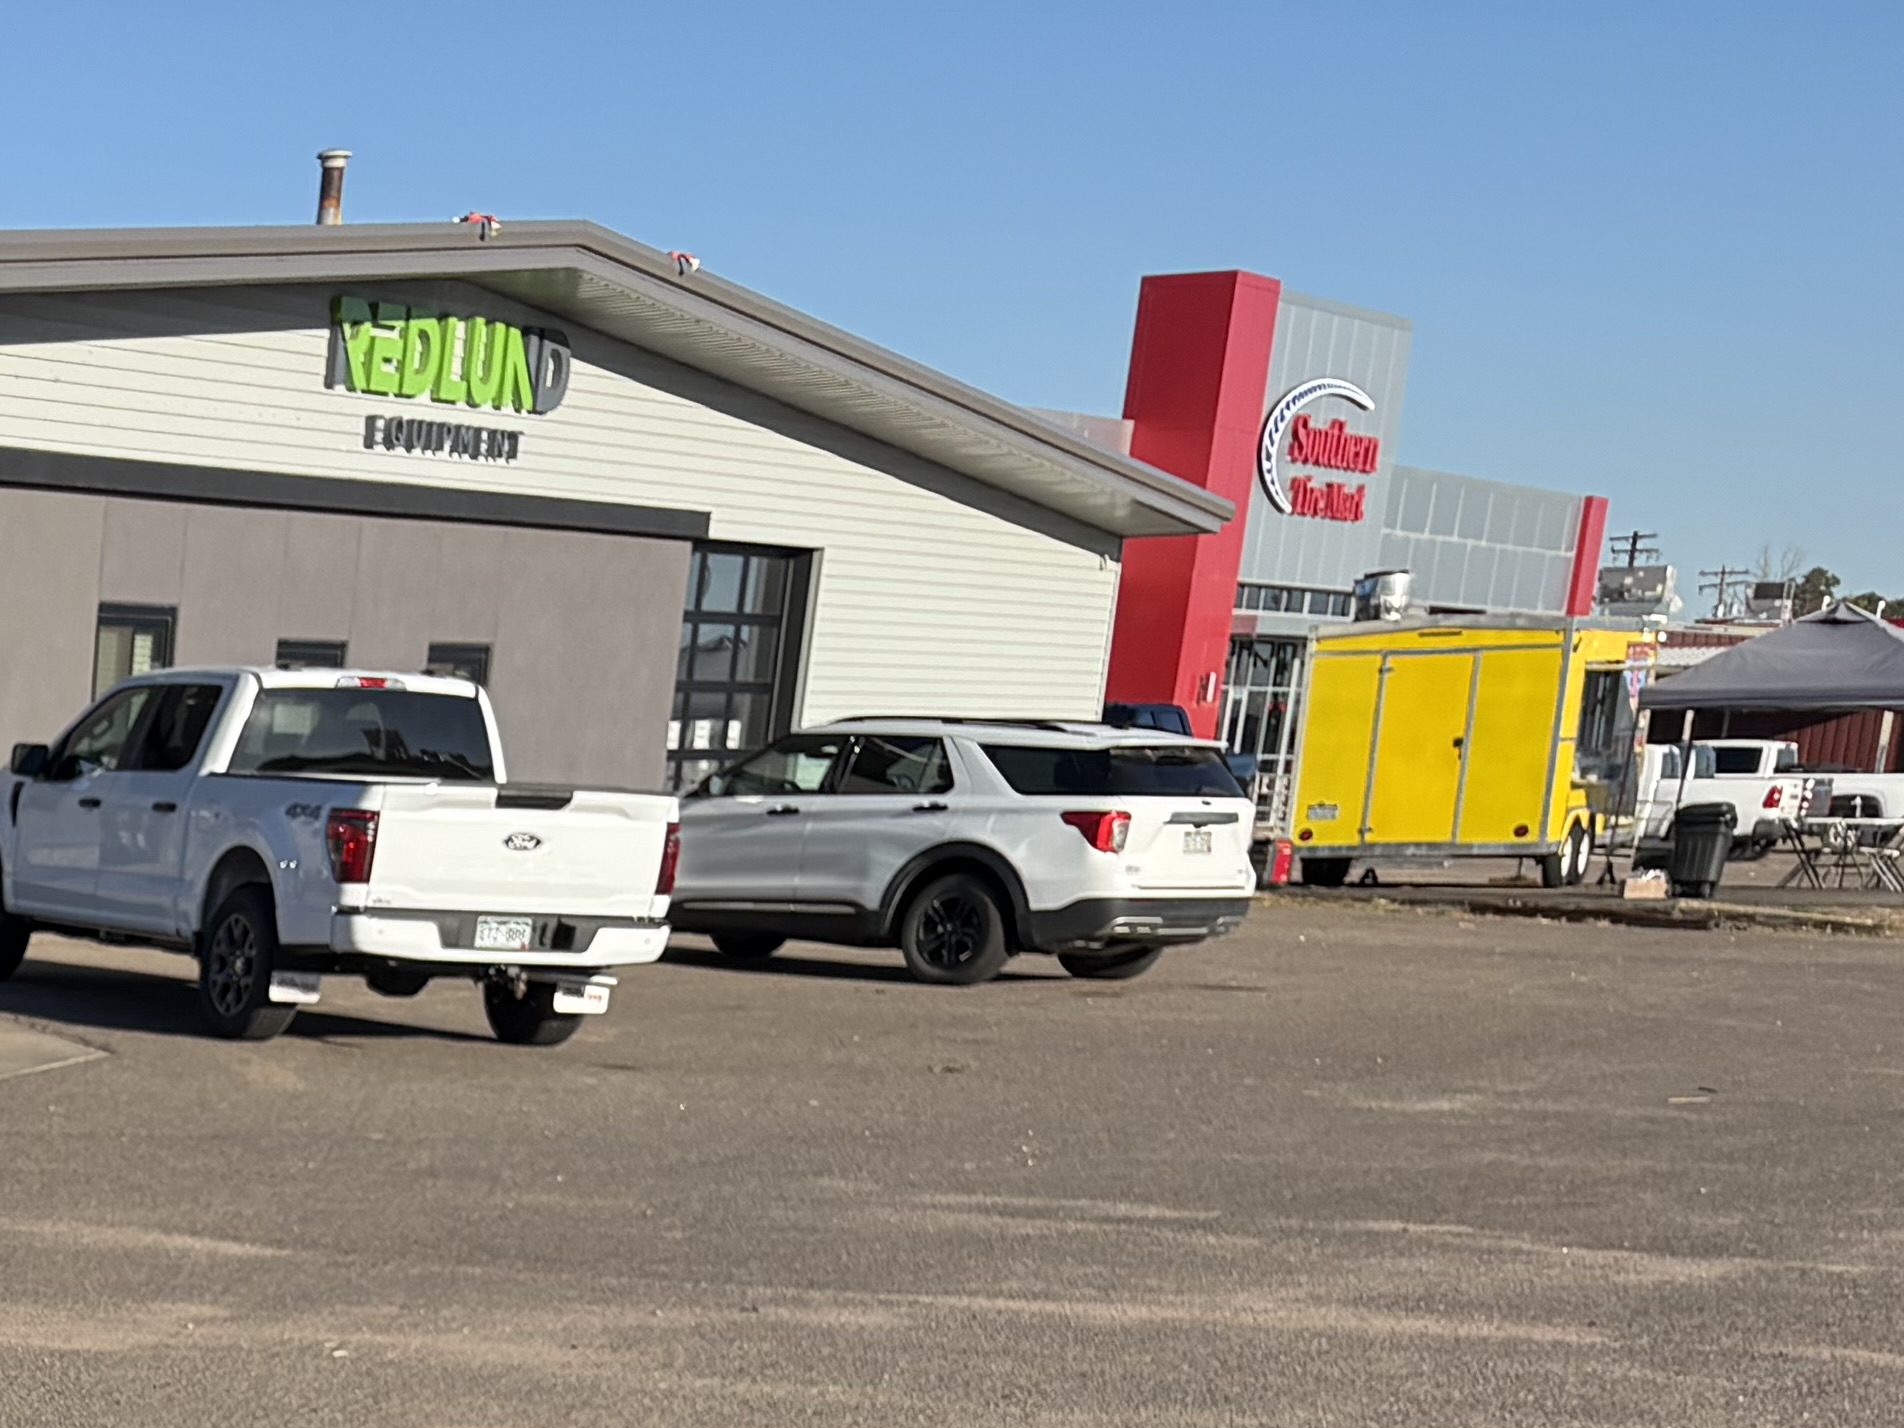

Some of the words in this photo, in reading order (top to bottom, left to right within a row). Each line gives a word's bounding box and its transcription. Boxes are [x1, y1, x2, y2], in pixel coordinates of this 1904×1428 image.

[324, 297, 571, 414] REDLUND
[363, 415, 524, 464] EQUIPMENT
[1288, 414, 1380, 474] Southern
